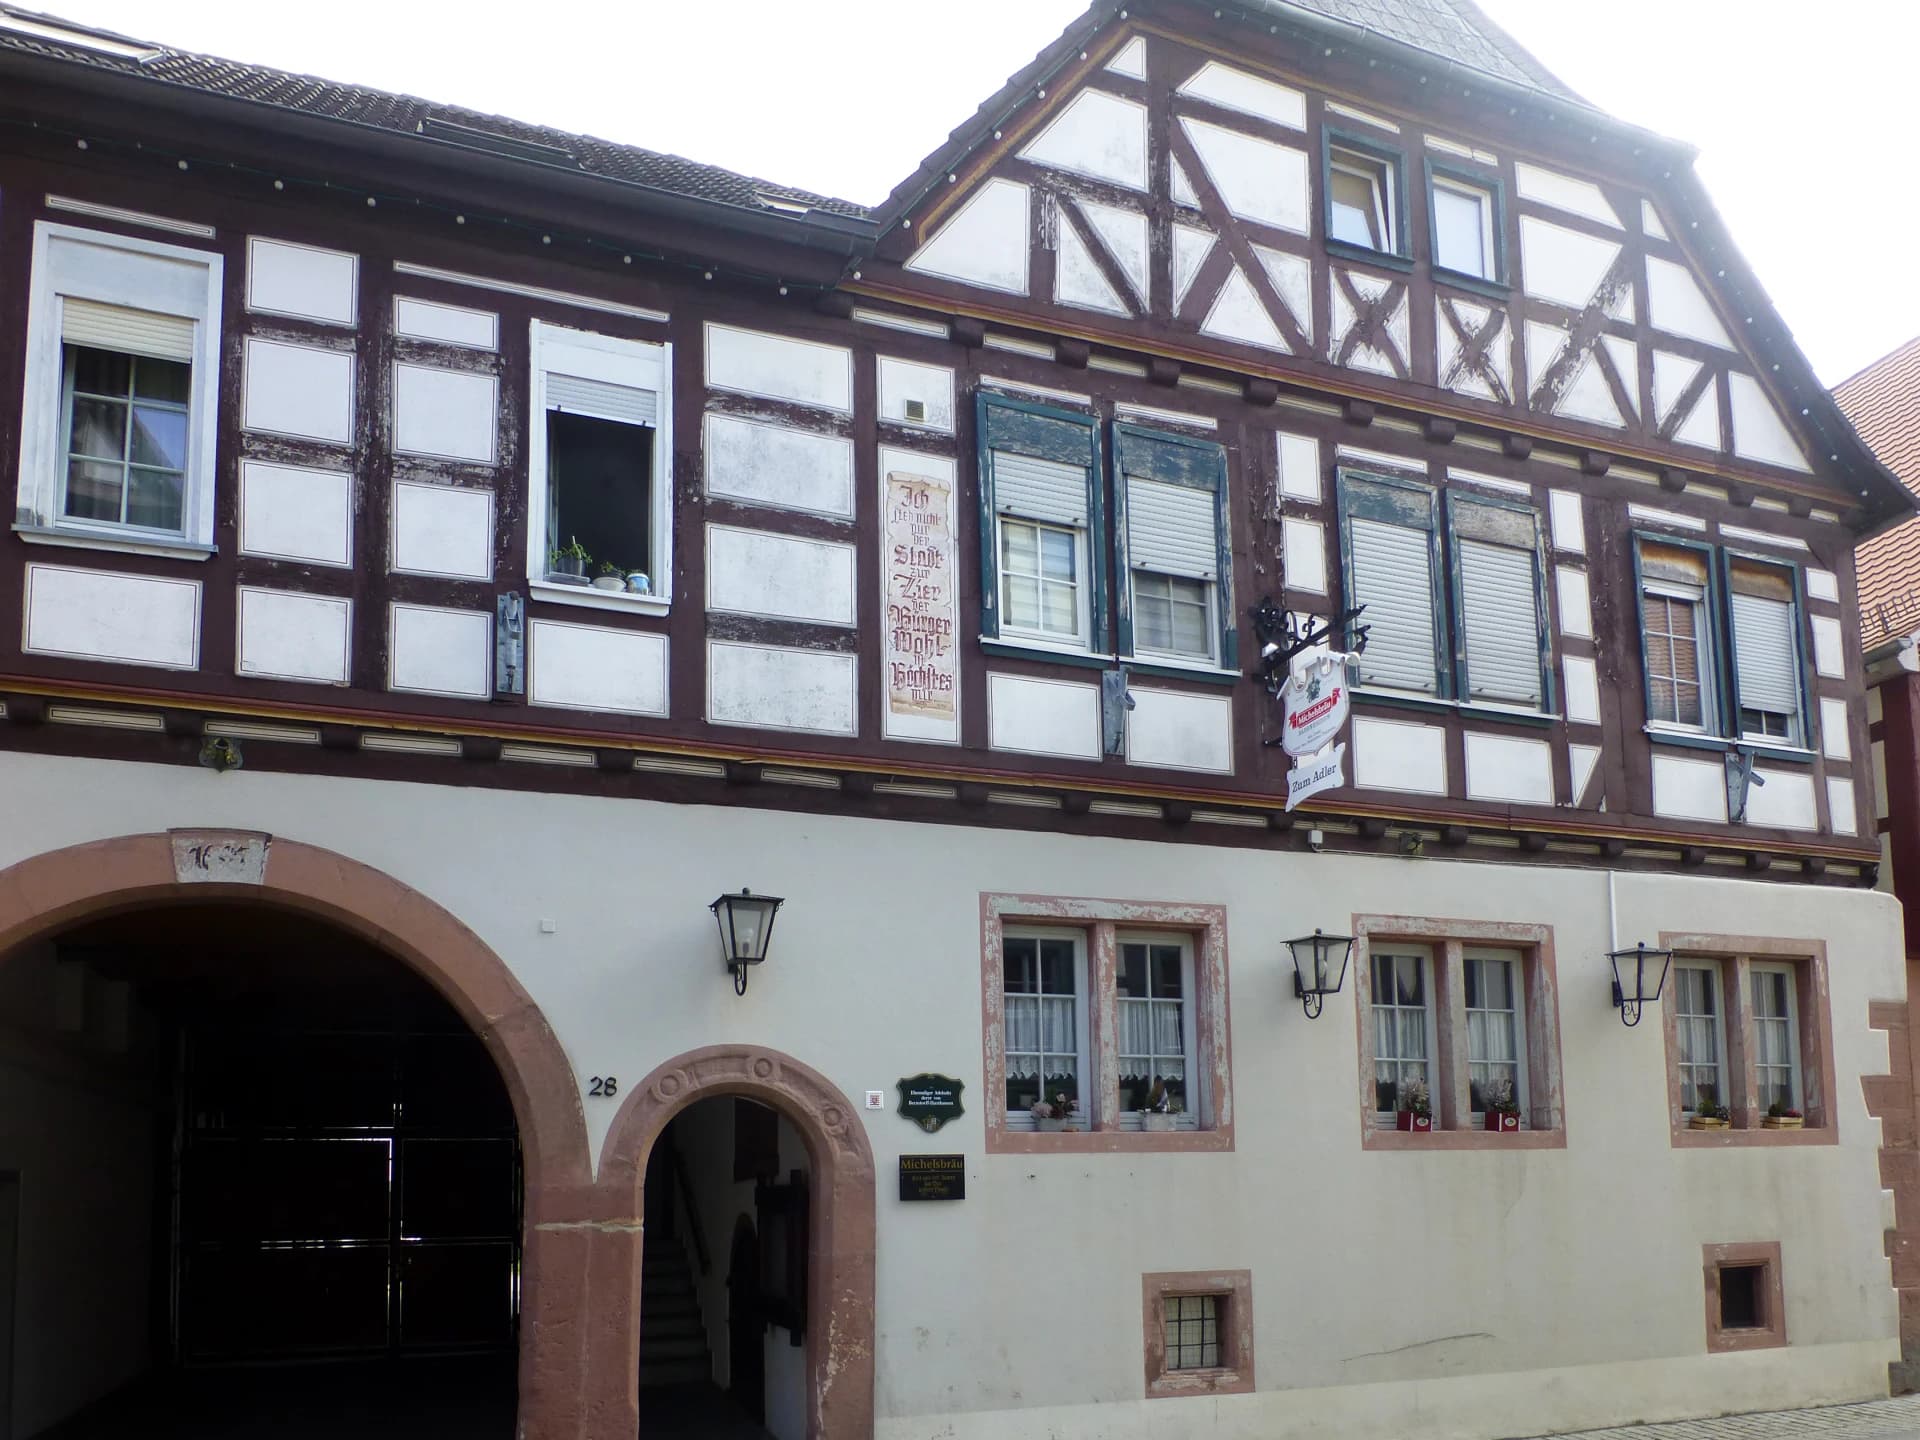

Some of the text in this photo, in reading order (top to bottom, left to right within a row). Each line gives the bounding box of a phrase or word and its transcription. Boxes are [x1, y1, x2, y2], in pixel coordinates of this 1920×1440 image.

[900, 485, 929, 511] Ich
[913, 535, 930, 547] der
[894, 545, 944, 569] Stadt
[910, 567, 930, 579] zur
[912, 599, 930, 613] der
[888, 604, 951, 636] Bürger
[1292, 764, 1337, 793] Zum Adler
[589, 1076, 617, 1097] 28
[901, 1159, 963, 1169] Michelsbräu
